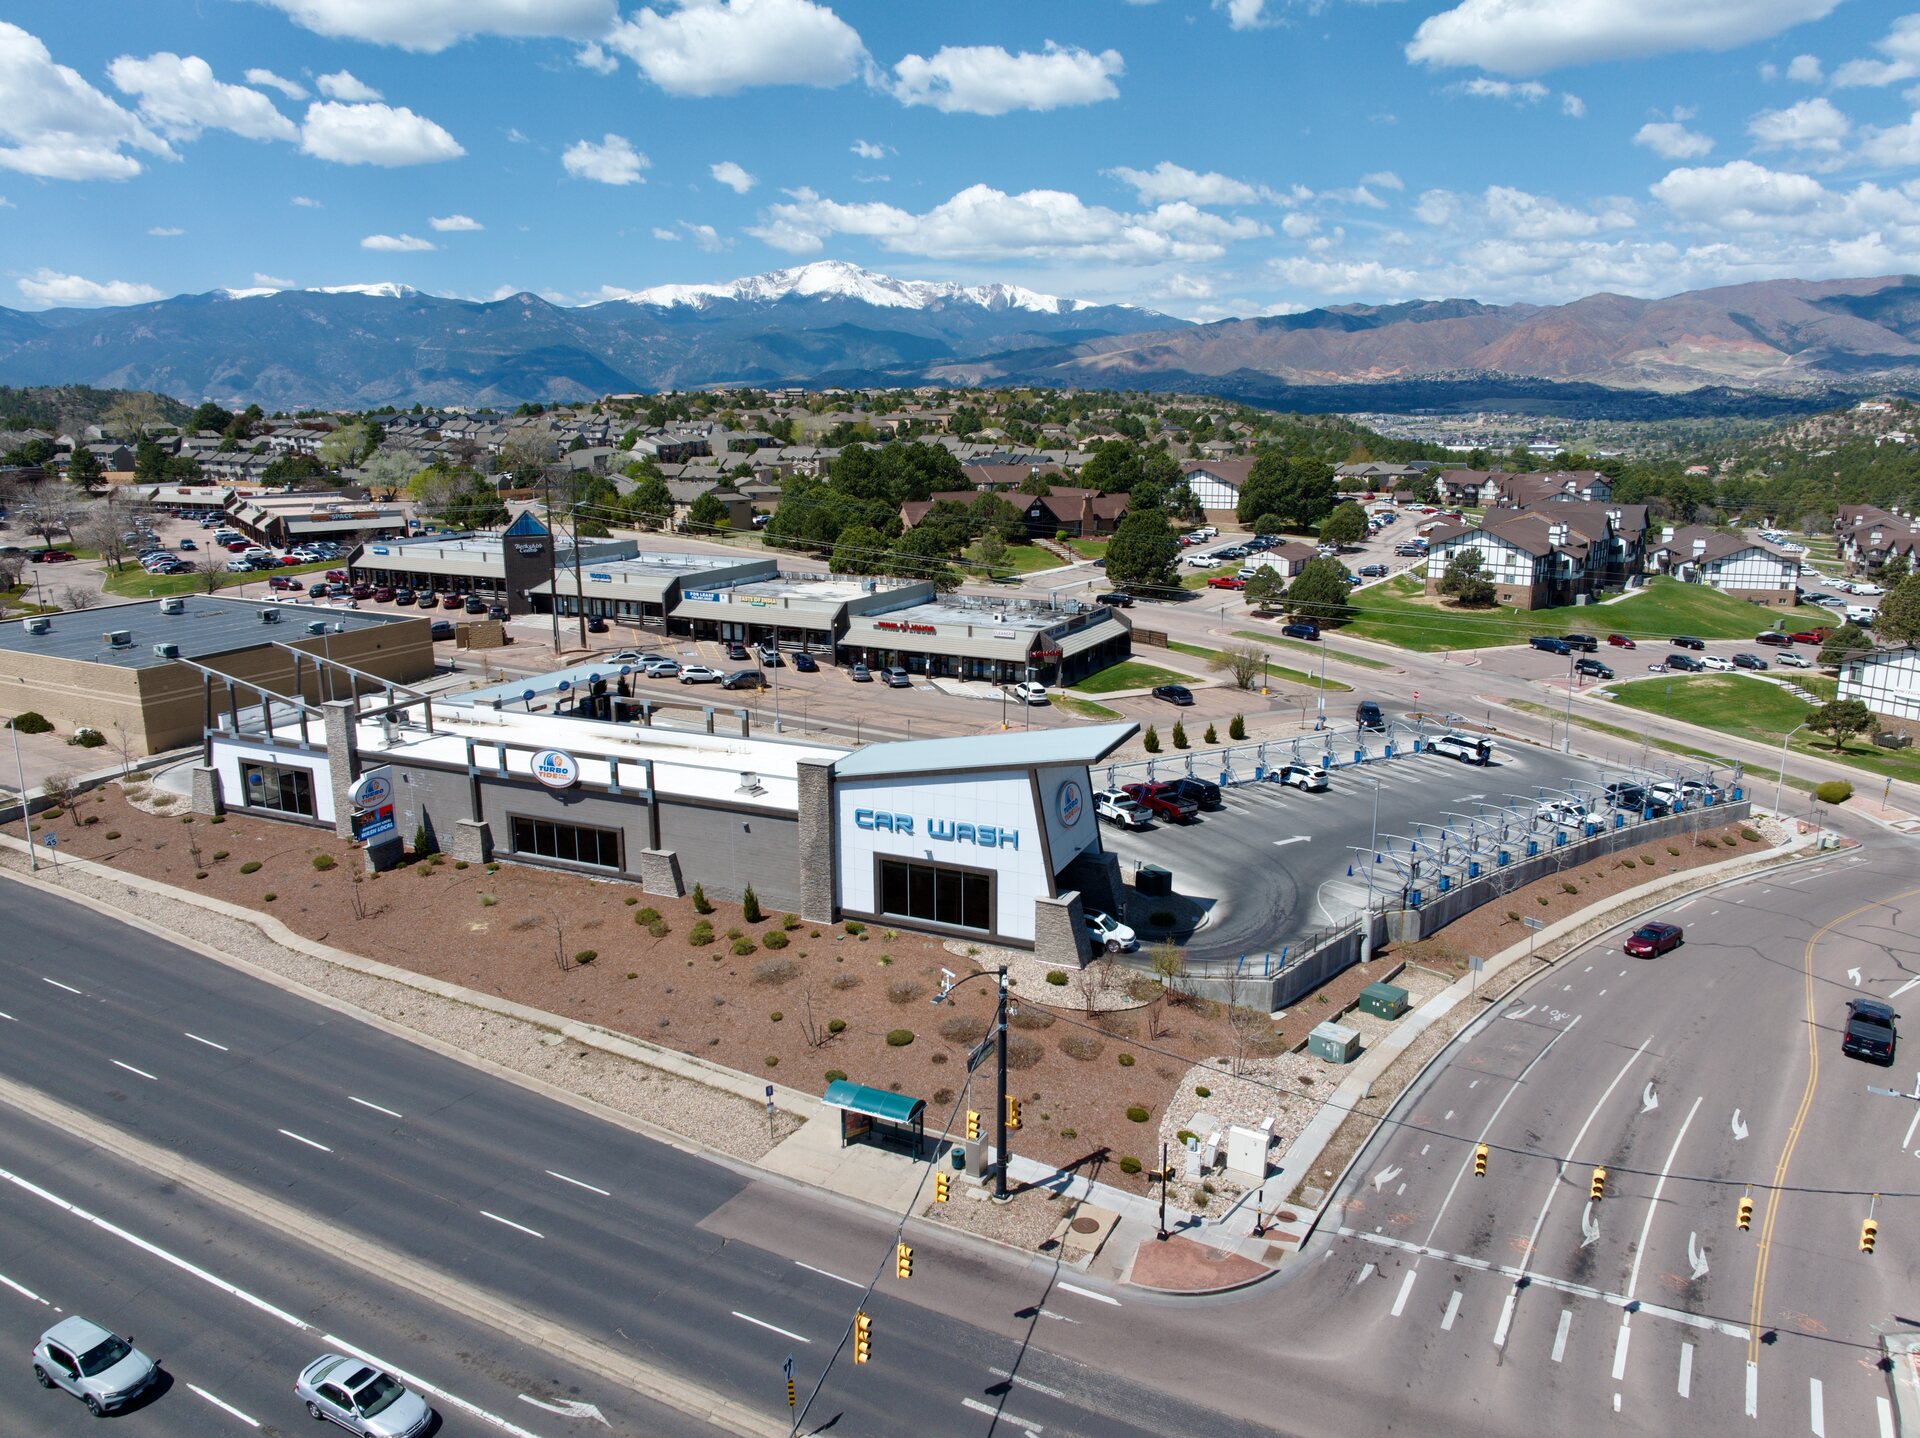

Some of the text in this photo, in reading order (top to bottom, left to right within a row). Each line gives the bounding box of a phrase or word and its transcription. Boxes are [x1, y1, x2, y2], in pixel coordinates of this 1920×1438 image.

[906, 624, 935, 633] LIQUOR
[539, 766, 568, 774] TURBO
[361, 788, 384, 800] TURBO
[361, 822, 393, 838] WASH LOCAL
[855, 808, 1019, 851] CAR WASH
